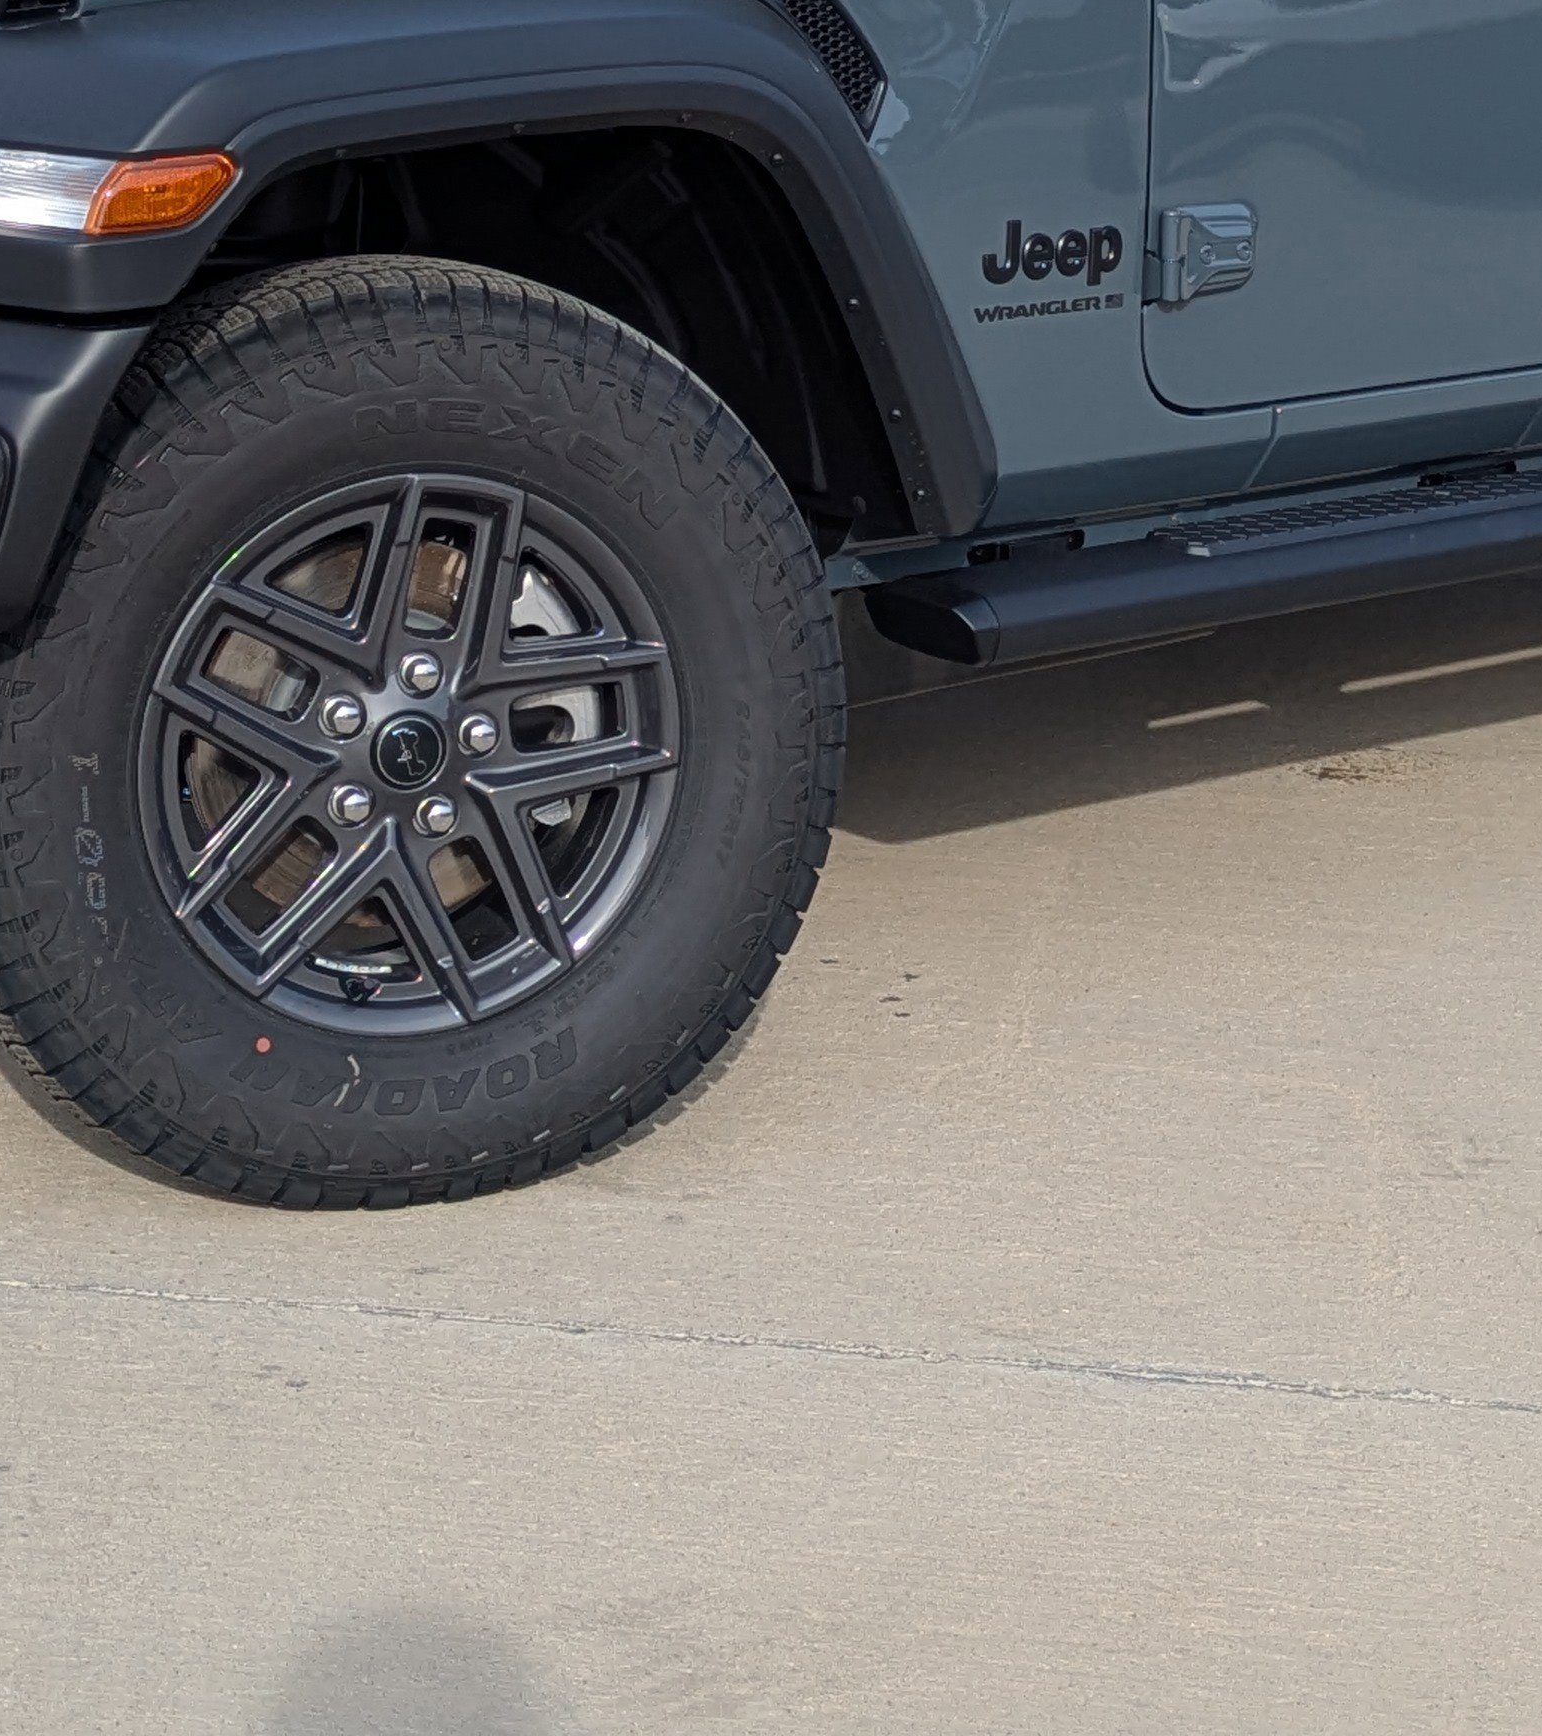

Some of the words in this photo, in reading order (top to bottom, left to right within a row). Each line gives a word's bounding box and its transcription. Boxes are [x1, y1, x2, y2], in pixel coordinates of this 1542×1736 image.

[982, 219, 1123, 286] Jeep
[973, 296, 1101, 324] WRANGLER
[353, 397, 678, 531] NEXEN
[227, 1027, 579, 1117] ROADIAN
